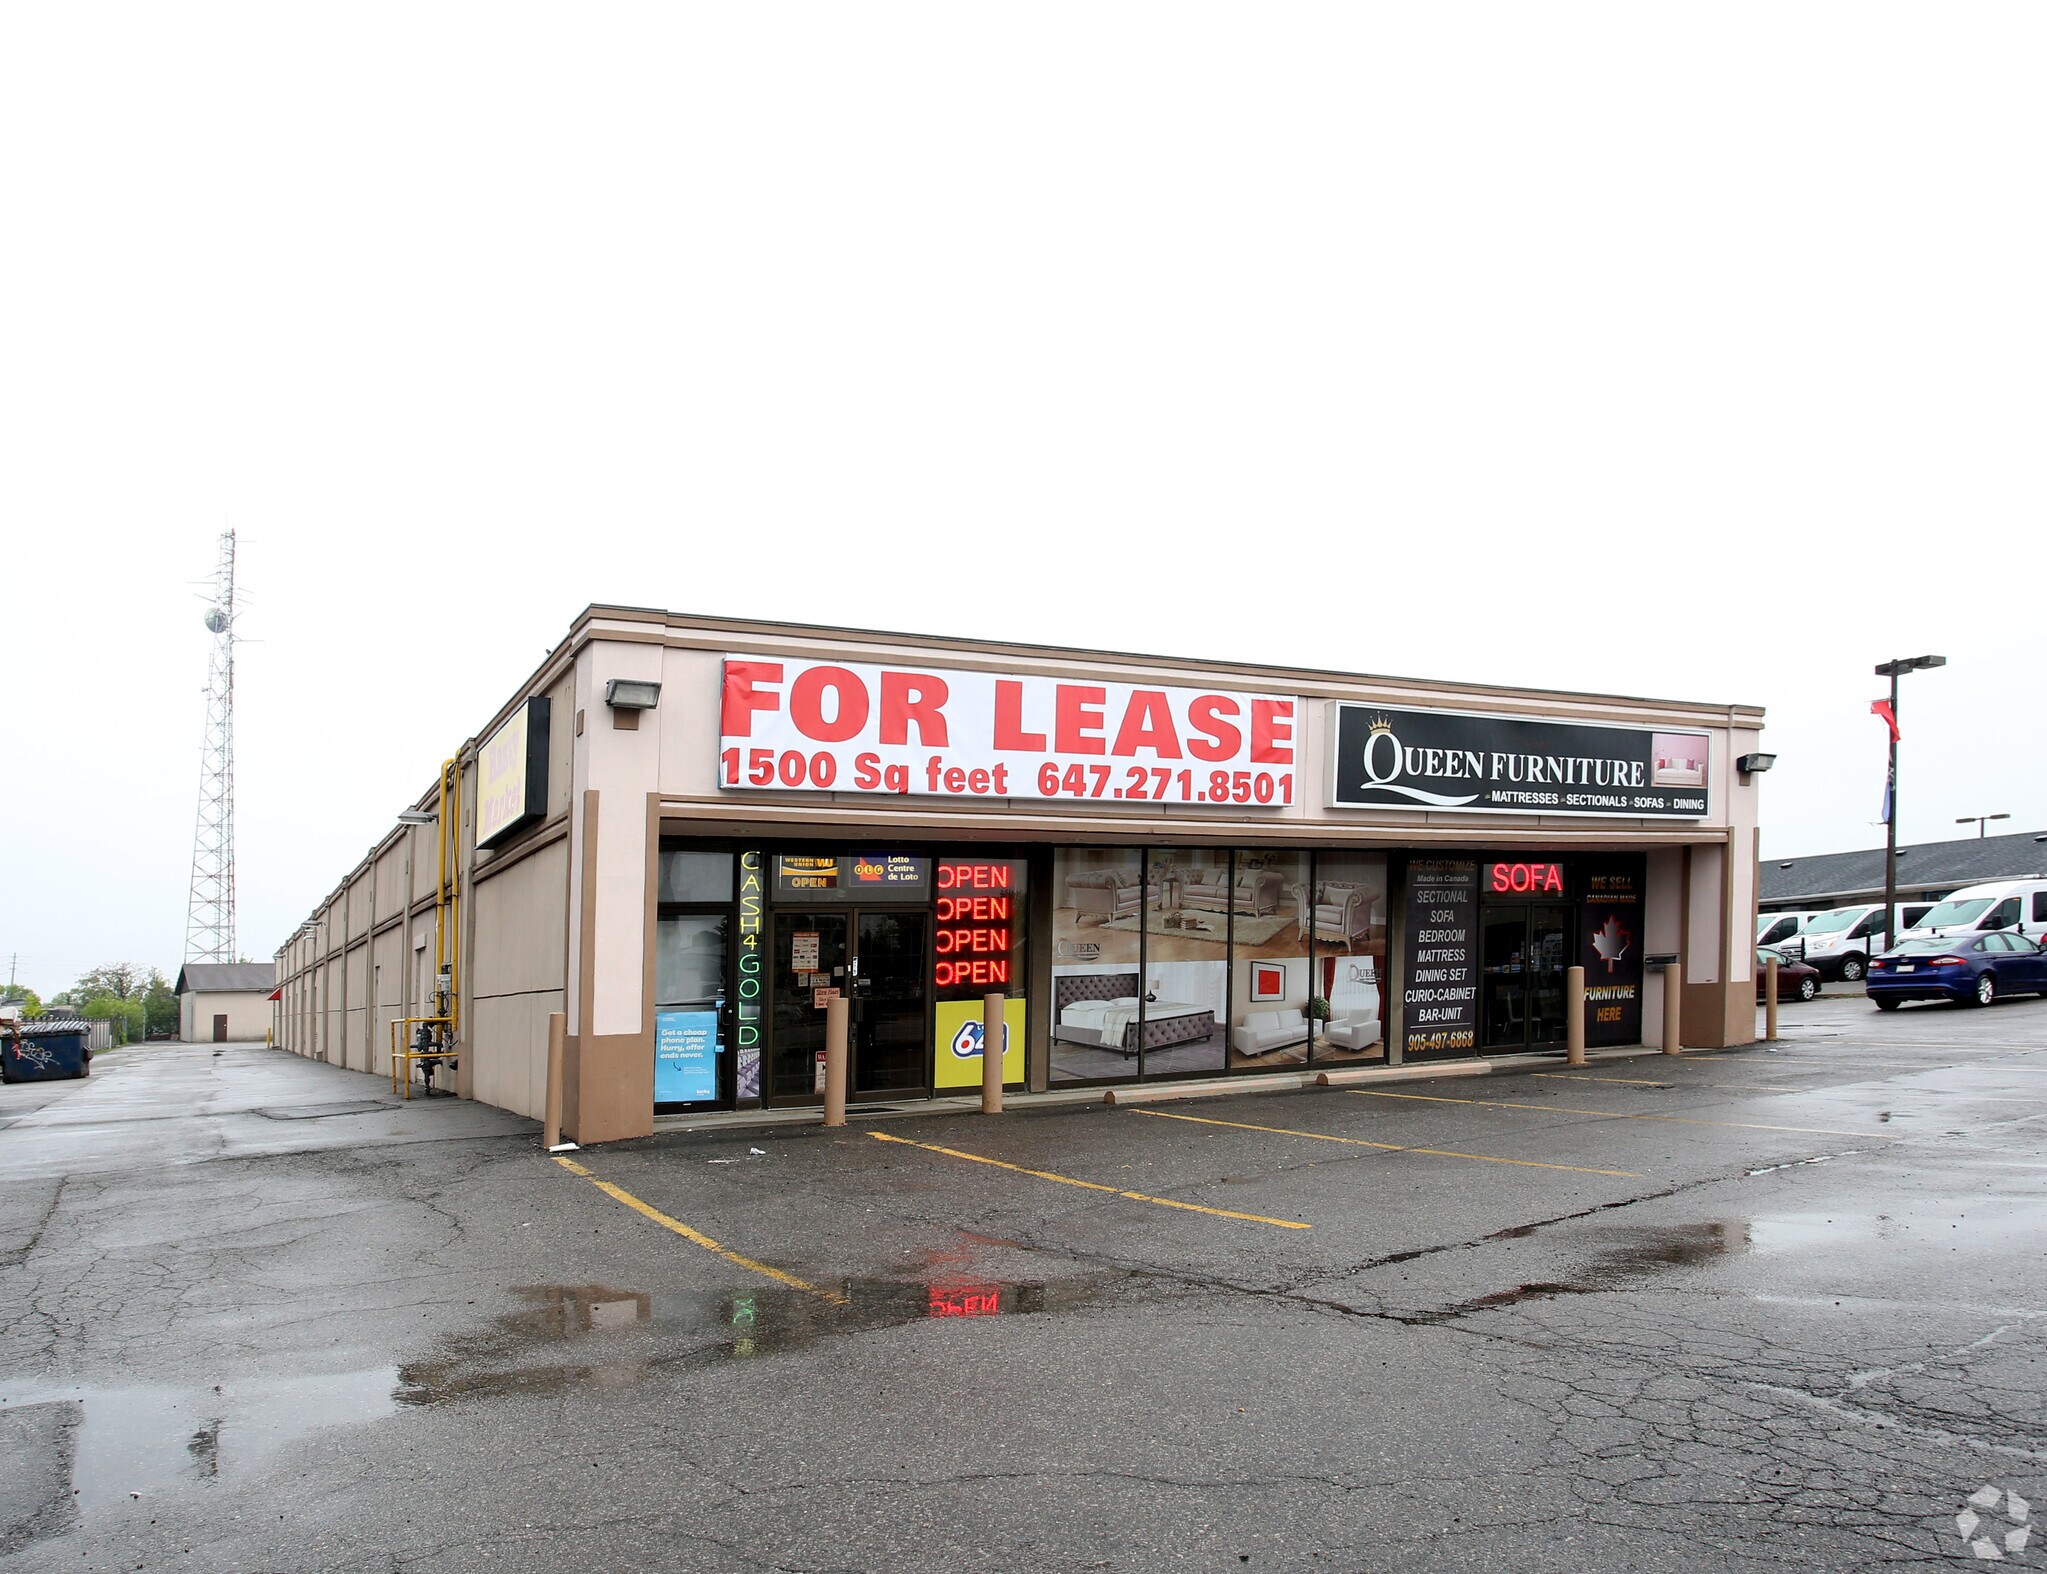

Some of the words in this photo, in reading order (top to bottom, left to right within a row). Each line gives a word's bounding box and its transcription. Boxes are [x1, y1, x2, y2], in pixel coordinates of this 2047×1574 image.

[722, 660, 950, 748] FOR
[993, 679, 1294, 765] LEASE
[722, 747, 837, 789] 1500
[854, 752, 909, 795] Sq
[925, 755, 1009, 795] feet
[1037, 761, 1293, 805] 647.271.8501
[1360, 731, 1486, 806] QUEEN
[1490, 752, 1646, 788] FURNITURE
[1491, 790, 1559, 804] MATTRESSES
[1566, 793, 1628, 807] SECTIONALS
[1633, 797, 1665, 808] SOFAS
[1673, 798, 1705, 810] DINING
[854, 864, 884, 875] OLG
[888, 864, 915, 872] Centre
[1408, 860, 1424, 871] WE
[1425, 860, 1476, 871] CUSTOMIZE
[791, 877, 827, 888] OPEN
[888, 873, 898, 881] de
[900, 873, 919, 881] Loto
[938, 865, 1008, 888] OPEN
[1492, 863, 1563, 892] SOFA
[1591, 876, 1606, 889] WE
[1609, 876, 1632, 889] SELL
[1416, 890, 1468, 903] SECTIONAL
[937, 897, 1008, 921] OPEN
[1430, 910, 1454, 923] SOFA
[936, 929, 1007, 952] OPEN
[1418, 929, 1466, 943] BEDROOM
[1417, 949, 1466, 962] MATTRESS
[935, 960, 1006, 985] OPEN
[1415, 969, 1448, 983] DINING
[1449, 968, 1467, 981] SET
[1405, 987, 1477, 1003] CURIO-CABINET
[1584, 985, 1635, 1001] FURNITURE
[1418, 1007, 1463, 1022] BAR-UNIT
[1597, 1007, 1622, 1022] HERE
[683, 1029, 707, 1037] cheap
[1408, 1030, 1474, 1052] 905-497-6868
[660, 1045, 685, 1053] Hurry,
